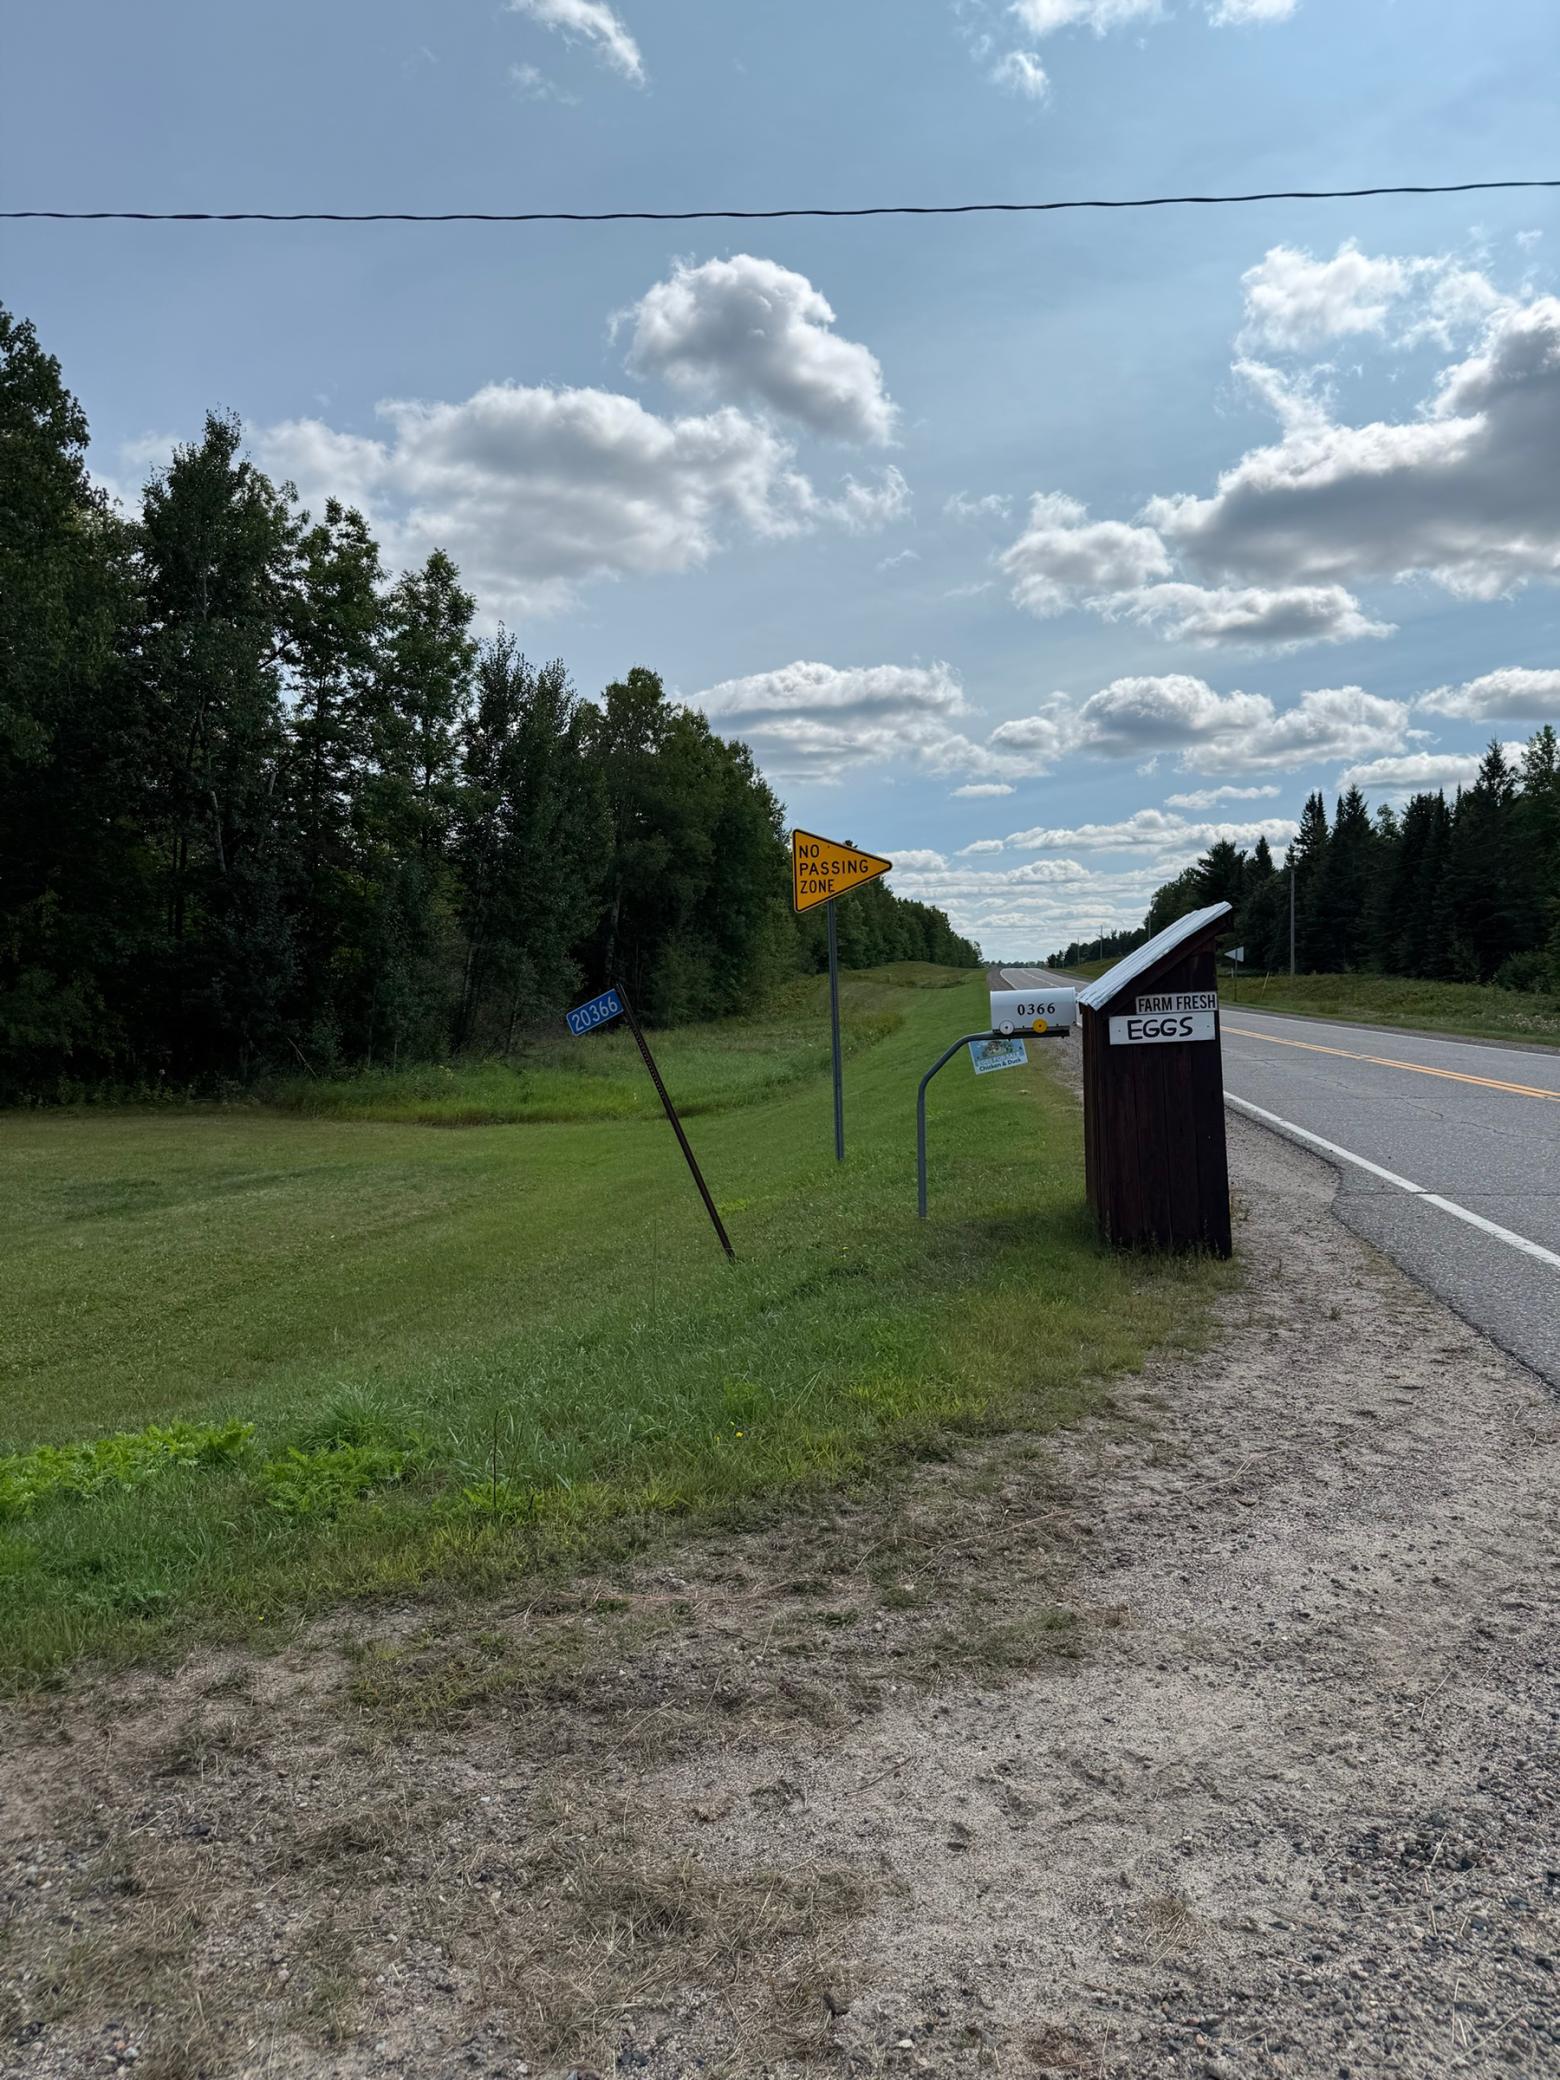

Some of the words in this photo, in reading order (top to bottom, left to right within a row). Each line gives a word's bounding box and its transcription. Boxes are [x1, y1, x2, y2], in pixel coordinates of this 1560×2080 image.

[799, 844, 820, 858] NO
[799, 860, 869, 876] PASSING
[800, 879, 835, 894] ZONE
[1017, 1003, 1056, 1016] 0366
[1138, 997, 1173, 1012] FARM
[1176, 994, 1216, 1010] FRESH
[571, 996, 618, 1032] 20366
[1127, 1017, 1193, 1040] EGGS
